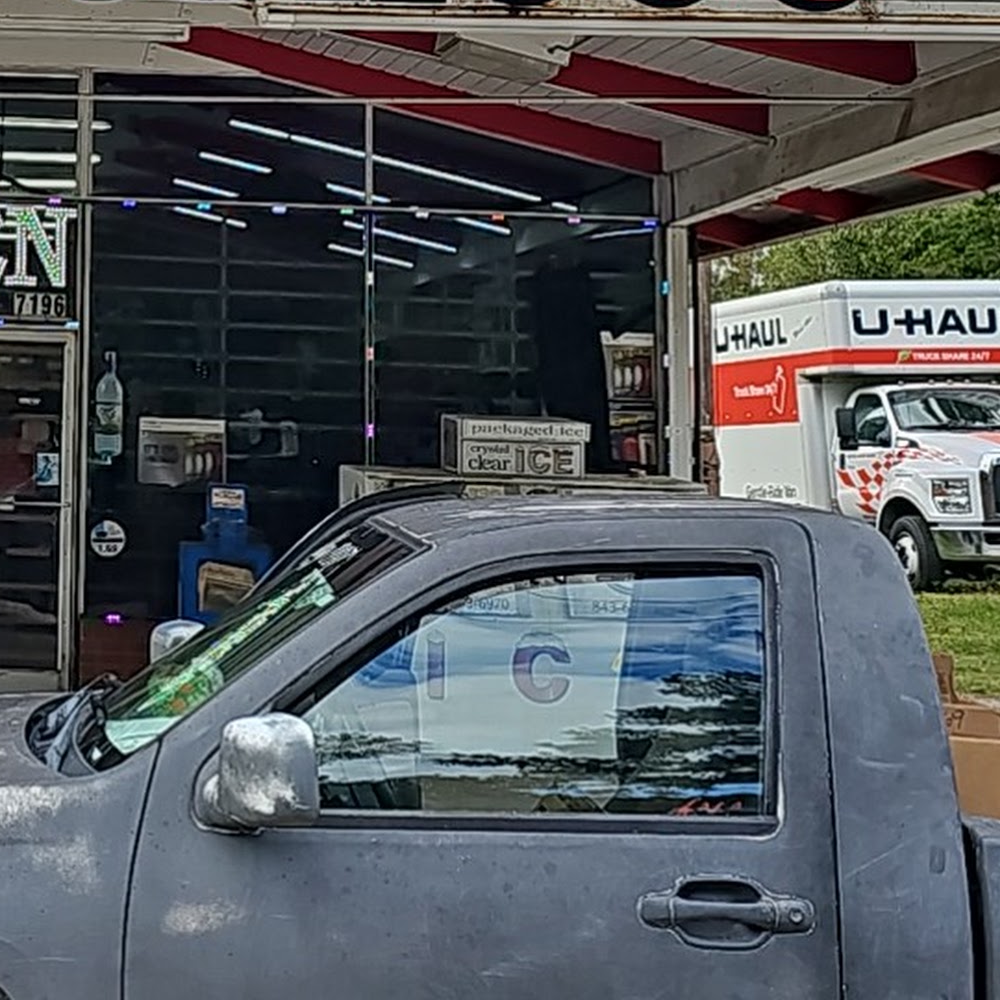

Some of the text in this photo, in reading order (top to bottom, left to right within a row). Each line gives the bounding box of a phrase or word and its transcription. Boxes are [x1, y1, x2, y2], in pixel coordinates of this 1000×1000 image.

[15, 293, 66, 316] 7196
[714, 316, 787, 354] U-HAUL
[852, 307, 998, 337] U-HAU
[472, 424, 553, 437] packaged
[468, 445, 574, 474] clear ICE
